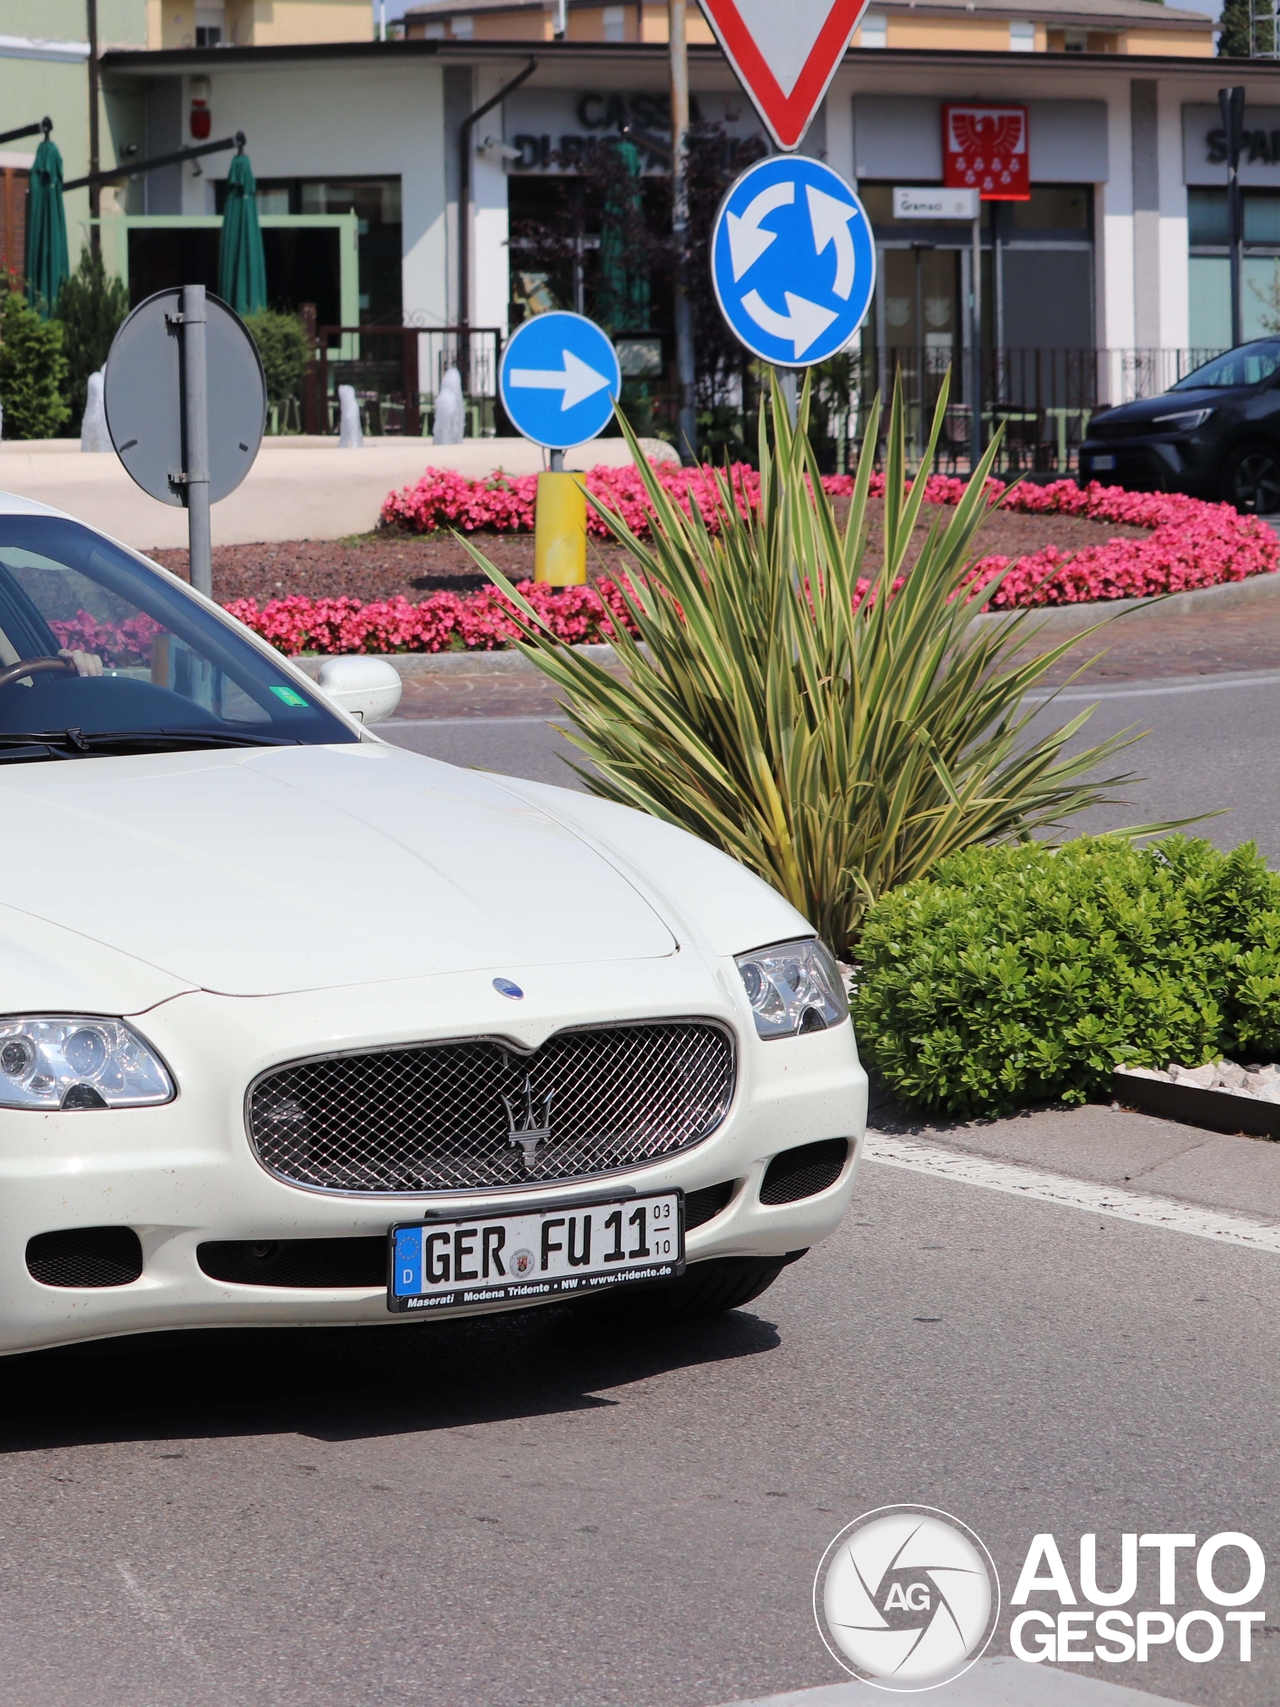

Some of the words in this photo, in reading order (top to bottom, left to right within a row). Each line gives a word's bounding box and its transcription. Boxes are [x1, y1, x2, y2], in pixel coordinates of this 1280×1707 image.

[653, 1204, 671, 1219] 03
[425, 1226, 506, 1284] GER
[540, 1214, 592, 1271] FU
[603, 1206, 651, 1263] 11
[654, 1239, 671, 1256] 10
[402, 1269, 414, 1285] D
[407, 1293, 455, 1308] Maserati
[464, 1288, 505, 1302] Modena
[508, 1283, 550, 1298] Tridente
[561, 1278, 579, 1290] NW
[589, 1265, 672, 1286] www.tridente.de
